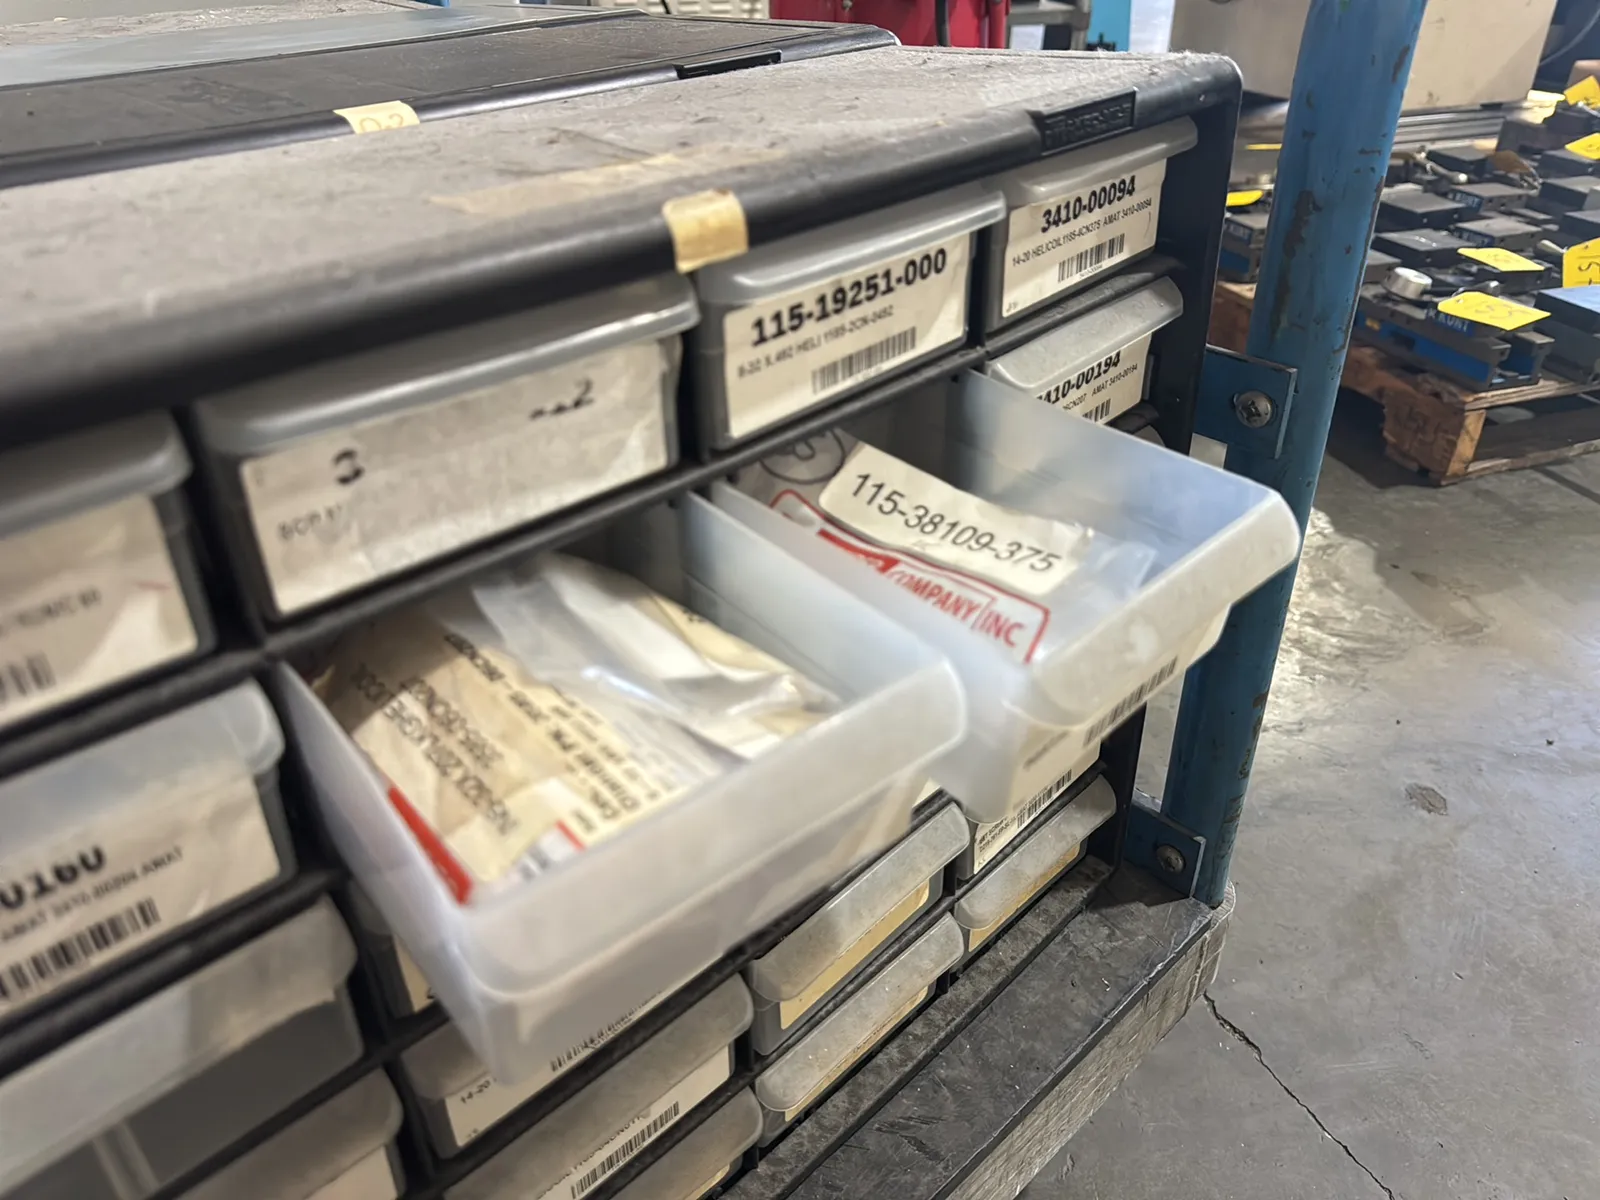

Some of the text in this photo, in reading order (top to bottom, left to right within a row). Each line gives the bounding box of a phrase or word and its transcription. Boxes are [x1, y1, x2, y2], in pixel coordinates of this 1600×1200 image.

[1041, 175, 1136, 233] 3410-00094
[752, 248, 947, 347] 115-19251-000
[1036, 350, 1121, 404] 410-00194
[850, 472, 1062, 573] 115-38109-375
[979, 610, 1025, 648] INC
